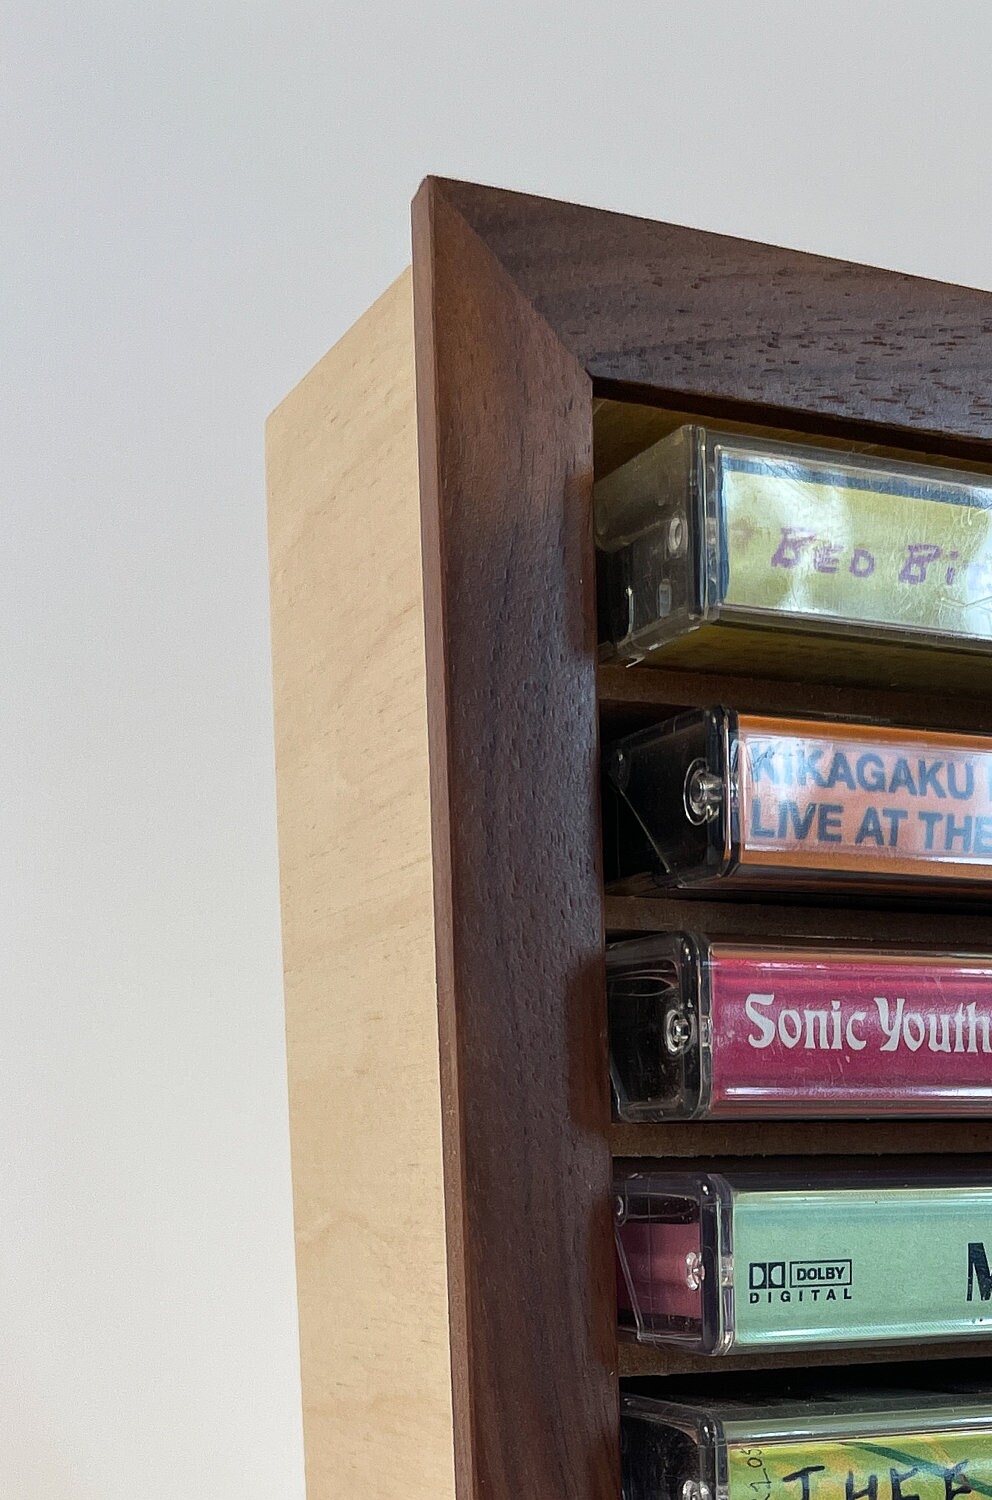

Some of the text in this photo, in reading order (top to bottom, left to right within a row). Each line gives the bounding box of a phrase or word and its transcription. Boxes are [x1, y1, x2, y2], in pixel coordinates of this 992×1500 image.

[751, 745, 975, 800] KIKAGAKU
[750, 799, 845, 843] LIVE
[855, 806, 908, 847] AT
[745, 992, 867, 1048] Sonic
[873, 997, 992, 1054] Youth
[749, 1288, 852, 1304] DIGITAL
[796, 1266, 845, 1282] DOLBY
